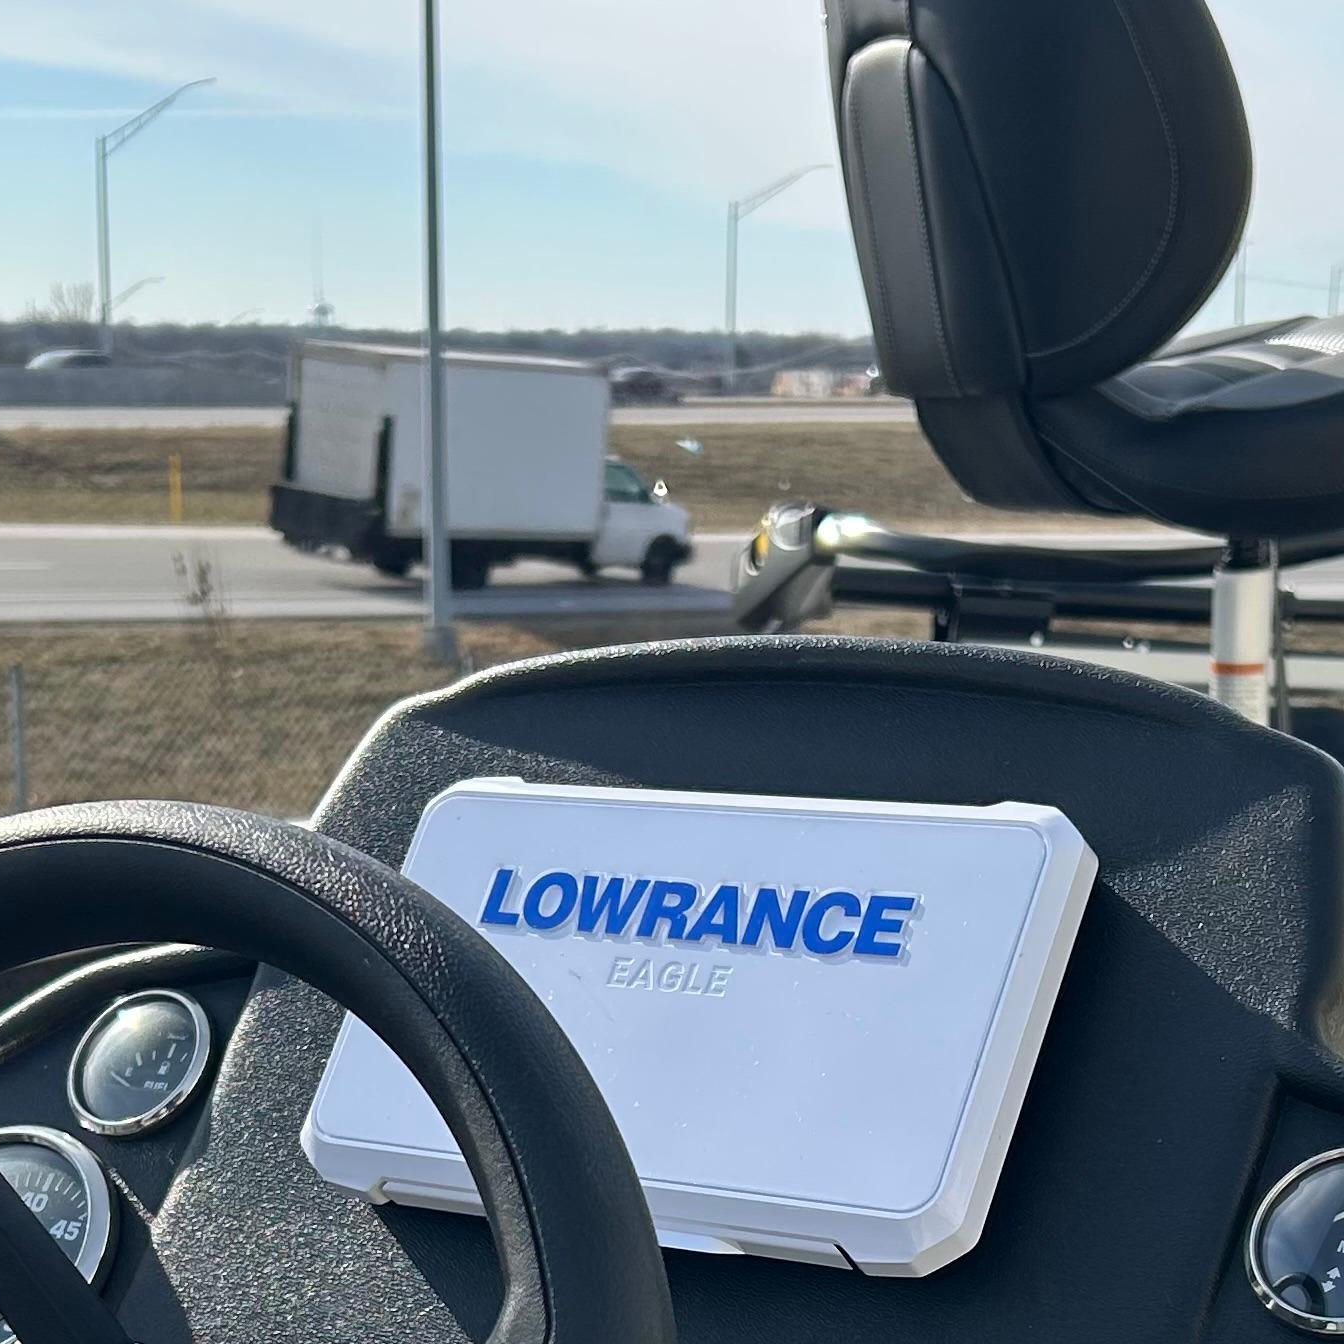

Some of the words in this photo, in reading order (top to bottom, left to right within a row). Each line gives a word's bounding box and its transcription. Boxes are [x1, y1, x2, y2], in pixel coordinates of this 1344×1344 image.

[479, 867, 918, 958] LOWRANCE
[606, 956, 733, 998] EAGLE
[21, 1191, 49, 1213] 40
[49, 1219, 82, 1241] 45
